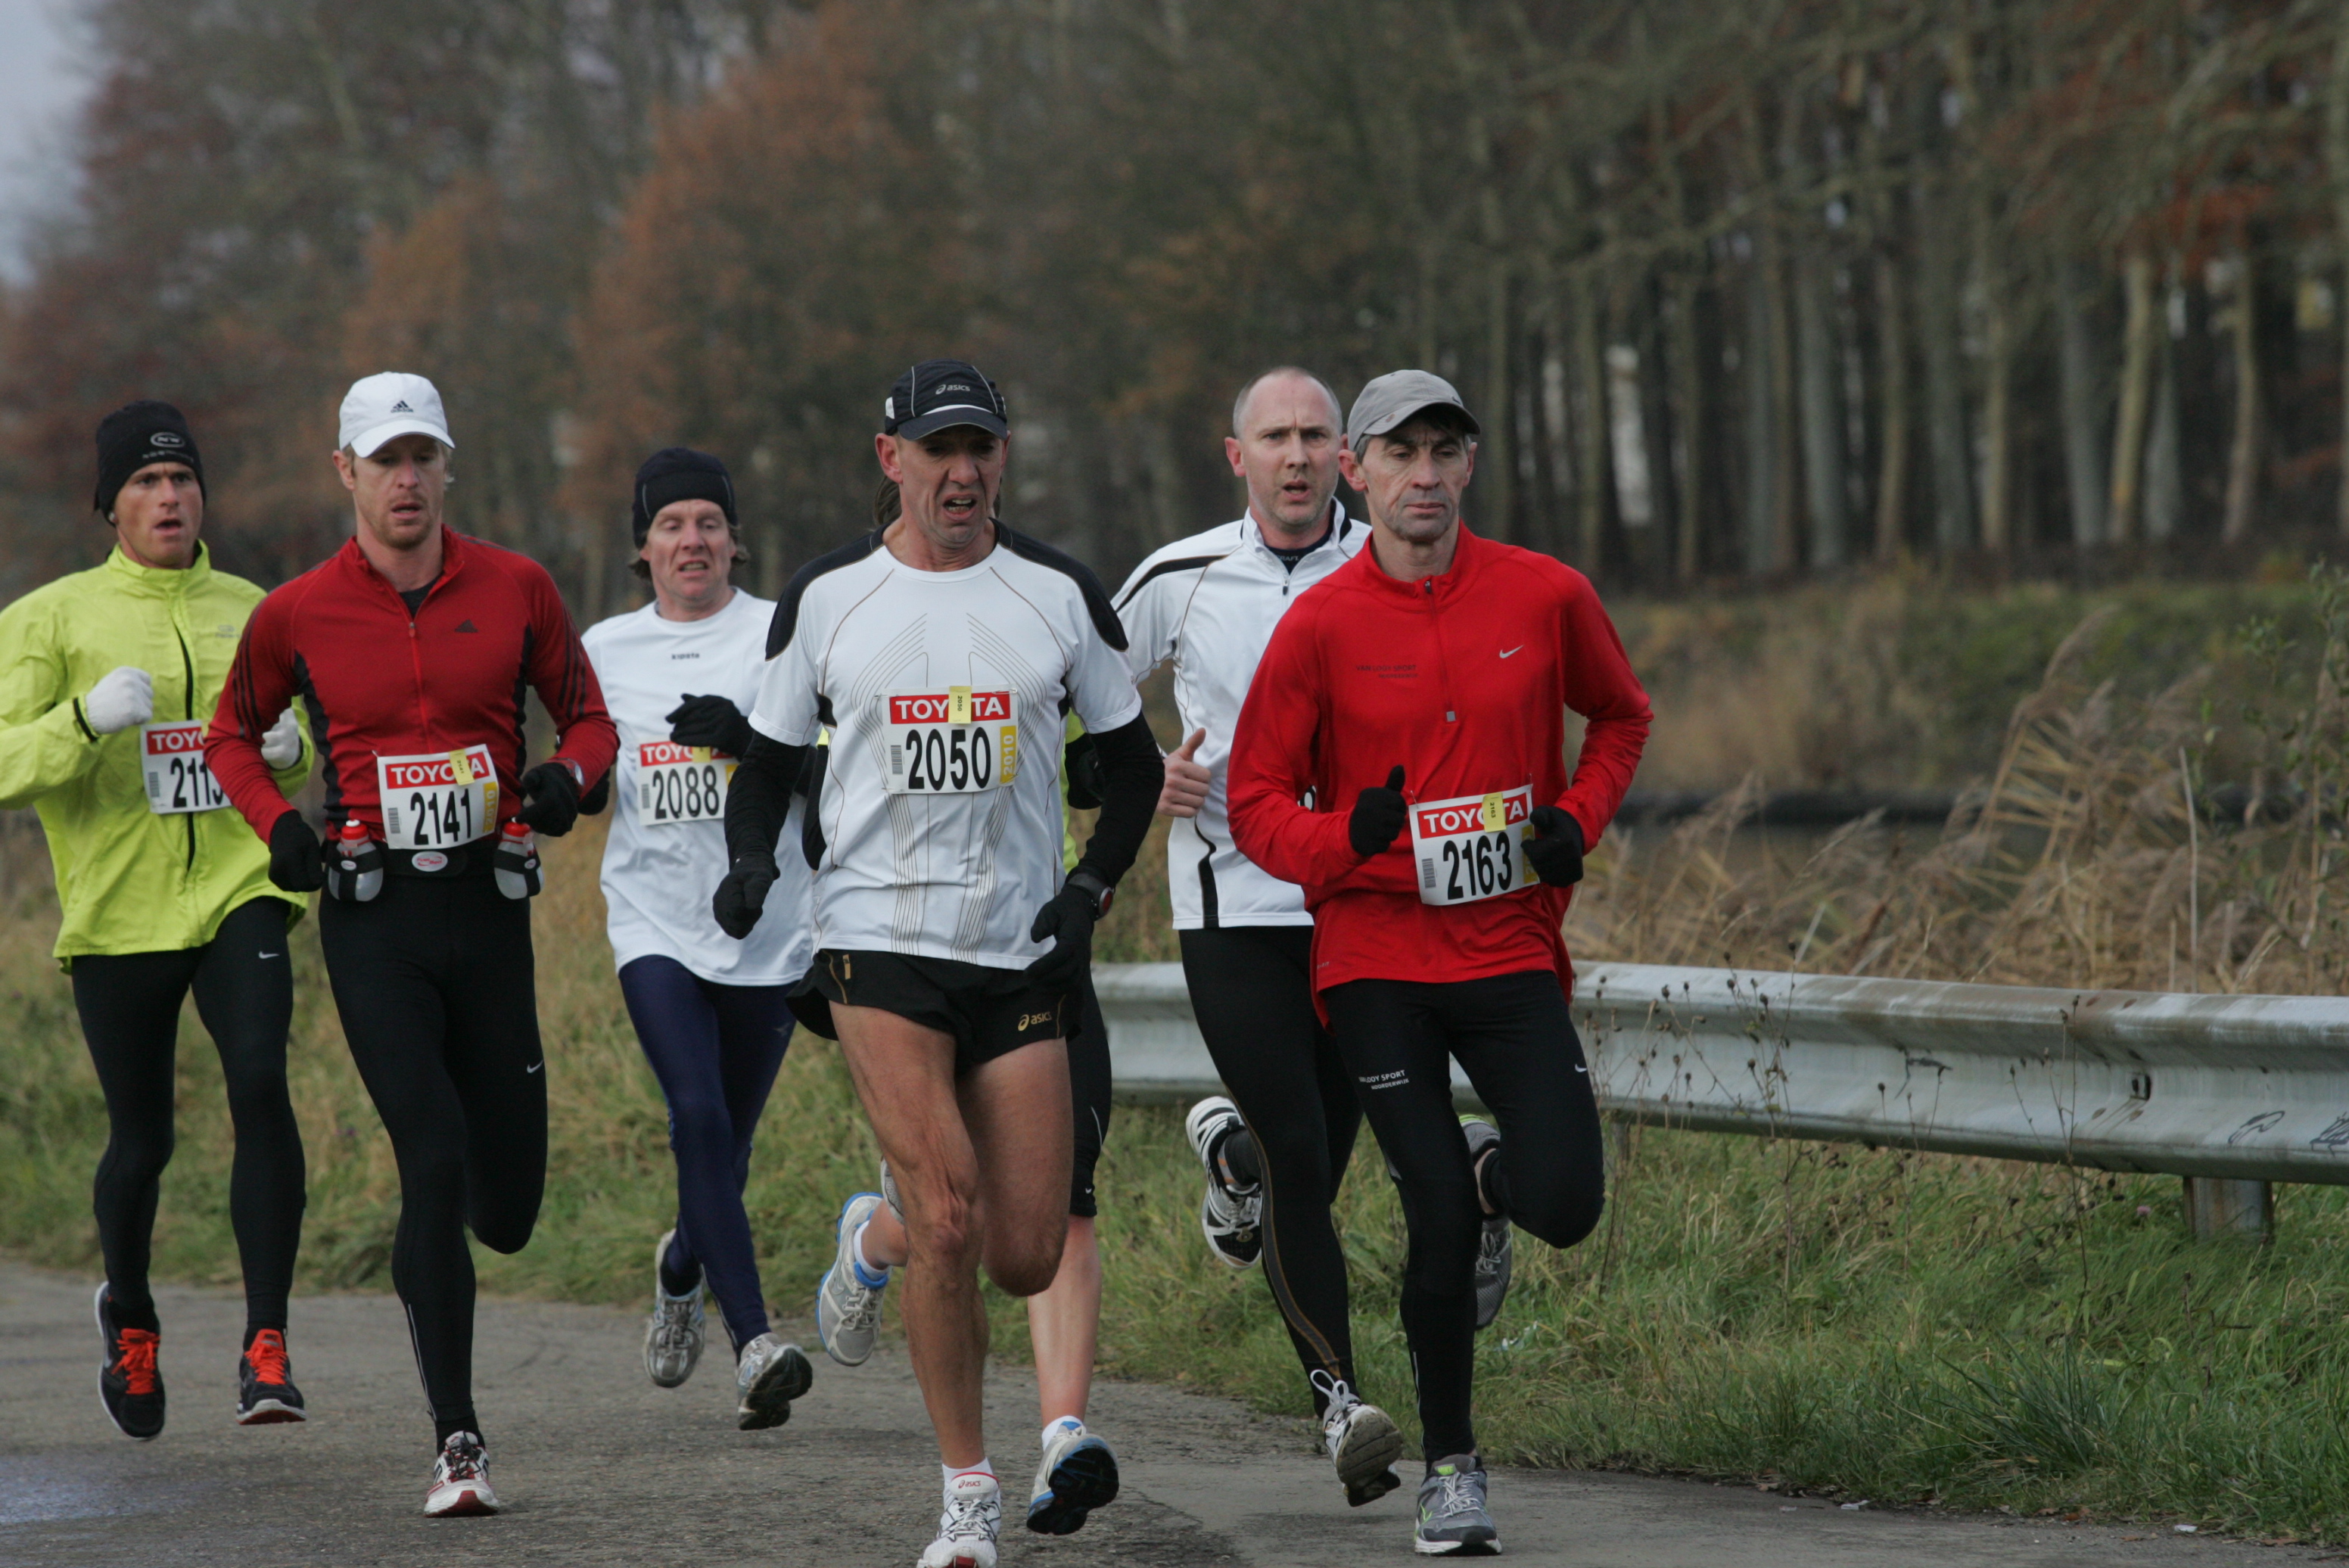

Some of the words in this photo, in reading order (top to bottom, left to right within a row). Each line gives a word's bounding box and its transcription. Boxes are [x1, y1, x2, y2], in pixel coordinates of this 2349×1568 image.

[895, 696, 1004, 720] TOYTA
[390, 758, 485, 785] TOYOA
[906, 726, 991, 791] 2050
[1003, 735, 1014, 776] 2010
[487, 789, 496, 824] 2010
[652, 765, 720, 820] 2088
[410, 789, 471, 845] 2141
[1443, 832, 1513, 900] 2163
[1030, 1011, 1053, 1025] asics
[1381, 1069, 1405, 1081] SPORT
